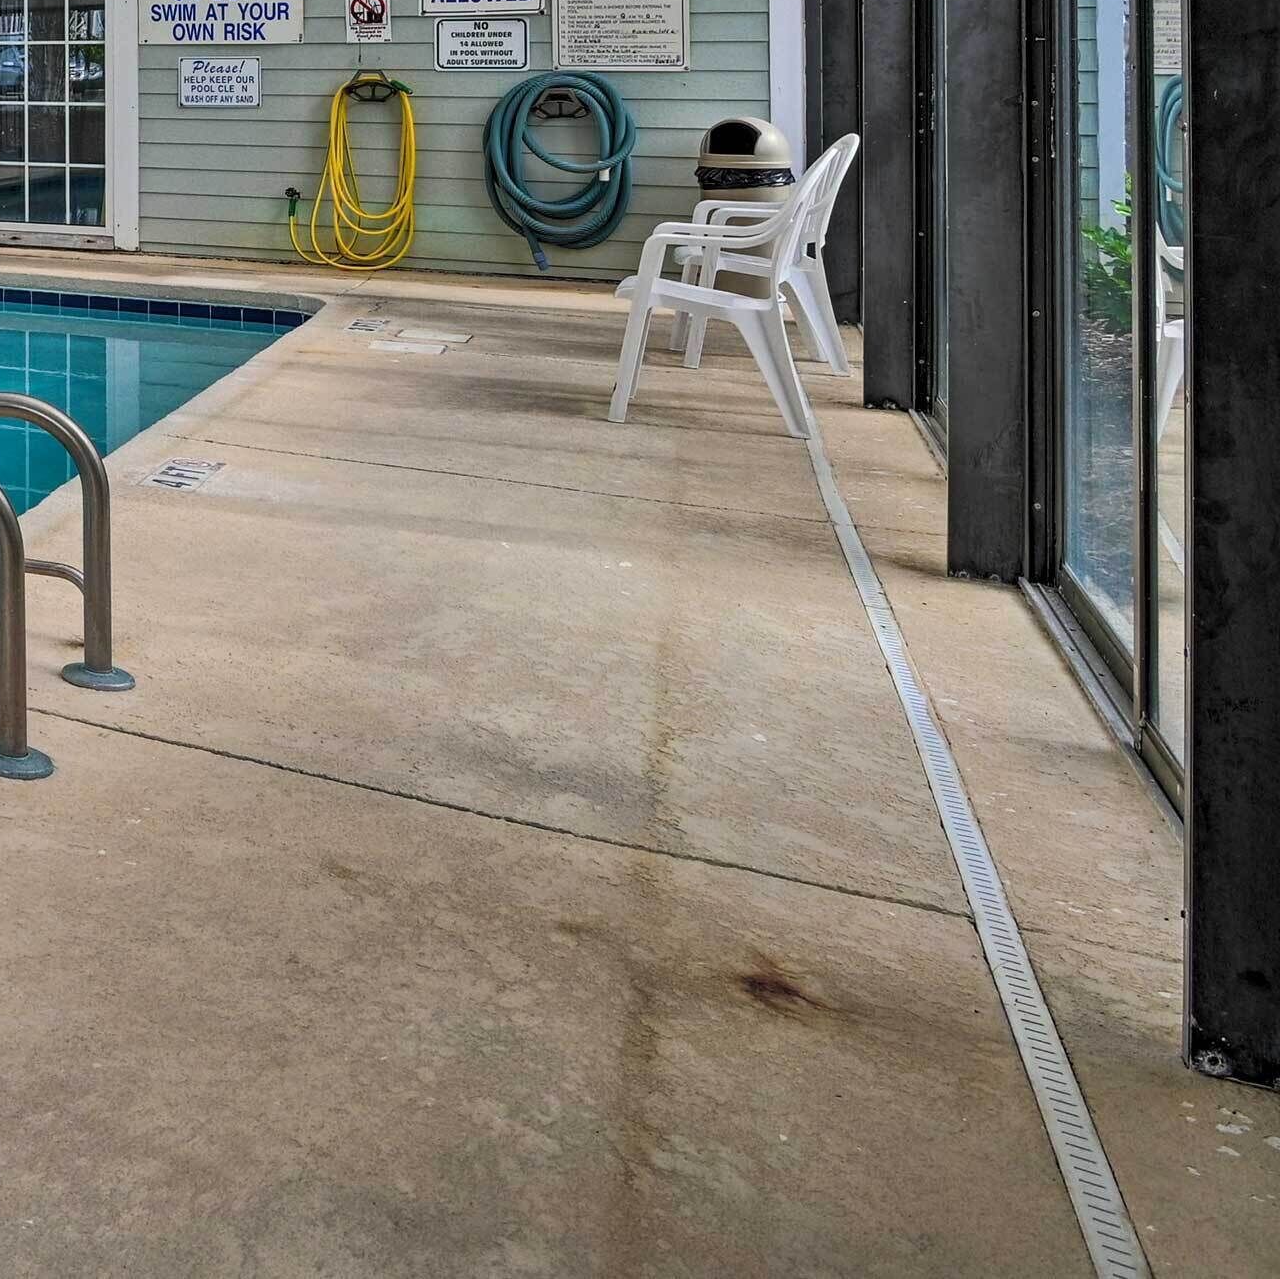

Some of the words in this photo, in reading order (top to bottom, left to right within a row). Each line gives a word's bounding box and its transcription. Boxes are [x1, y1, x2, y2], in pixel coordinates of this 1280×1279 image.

[151, 3, 196, 22] SWIM
[205, 3, 228, 21] AT
[238, 2, 289, 21] YOUR
[474, 21, 489, 30] NO
[173, 23, 214, 41] OWN
[224, 23, 266, 41] RISK
[192, 60, 246, 74] Please!
[191, 85, 215, 93] POOL
[218, 85, 248, 93] CLEN
[184, 95, 204, 103] WASH
[205, 95, 218, 103] OFF
[220, 95, 234, 103] ANY
[236, 95, 254, 103] SAND
